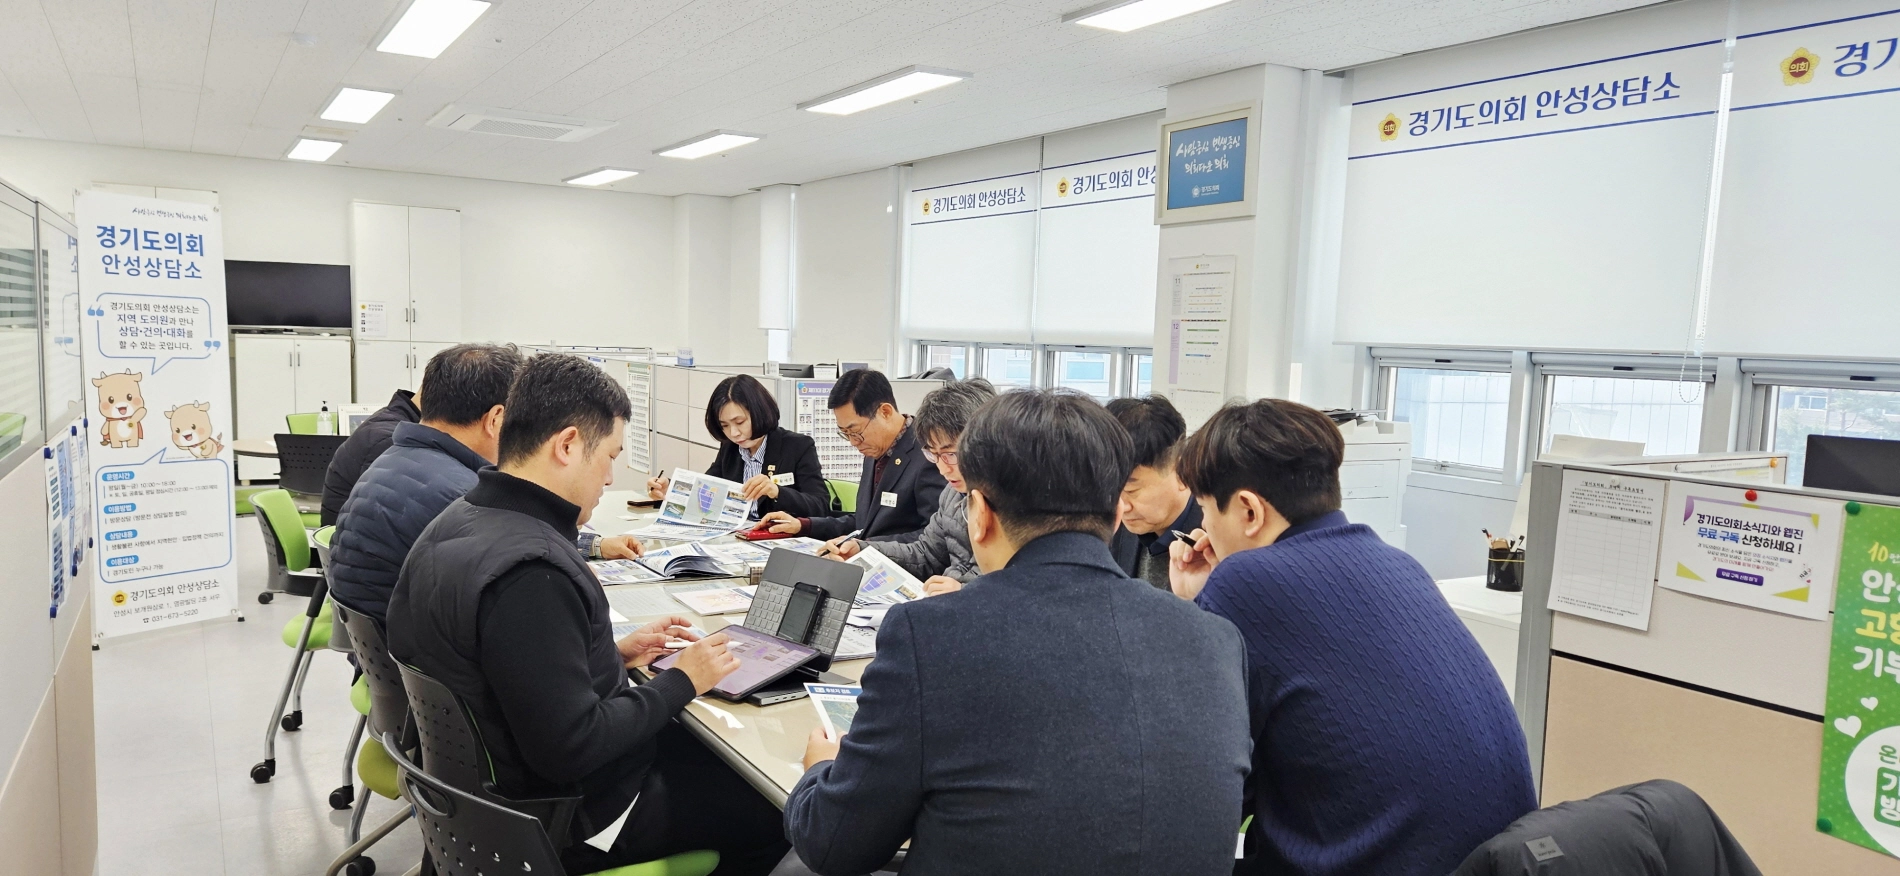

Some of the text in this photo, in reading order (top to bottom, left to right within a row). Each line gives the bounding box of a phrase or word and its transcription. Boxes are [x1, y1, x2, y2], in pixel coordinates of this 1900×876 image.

[1790, 62, 1808, 72] 의회
[1408, 72, 1680, 136] 경기도의회 안성상담소
[1176, 140, 1209, 157] 사람중심
[1184, 154, 1230, 174] 의회다운 의회
[1073, 169, 1132, 194] 경기도의회
[934, 186, 1026, 214] 경기도의회 안성상담소
[96, 225, 204, 257] 경기도의회
[102, 254, 202, 279] 안성상담소
[110, 302, 200, 314] 경기도의회 안성상담소는
[117, 314, 194, 326] 지역 도의원과 만나
[120, 340, 192, 350] 할 수 있는 곳입니다.
[106, 472, 130, 480] 운영시간
[108, 504, 132, 512] 이용방법
[1696, 513, 1804, 540] 경기도의회소식지와 웹진
[110, 532, 133, 540] 상담내용
[1698, 526, 1717, 540] 무료
[1720, 530, 1740, 544] 구독
[1742, 534, 1795, 554] 신청하세요
[110, 556, 134, 566] 이용대상
[130, 579, 220, 602] 경기도의회 안성상담소
[1862, 569, 1900, 604] 안
[114, 610, 132, 618] 안성시
[152, 608, 198, 622] 031-673-5220
